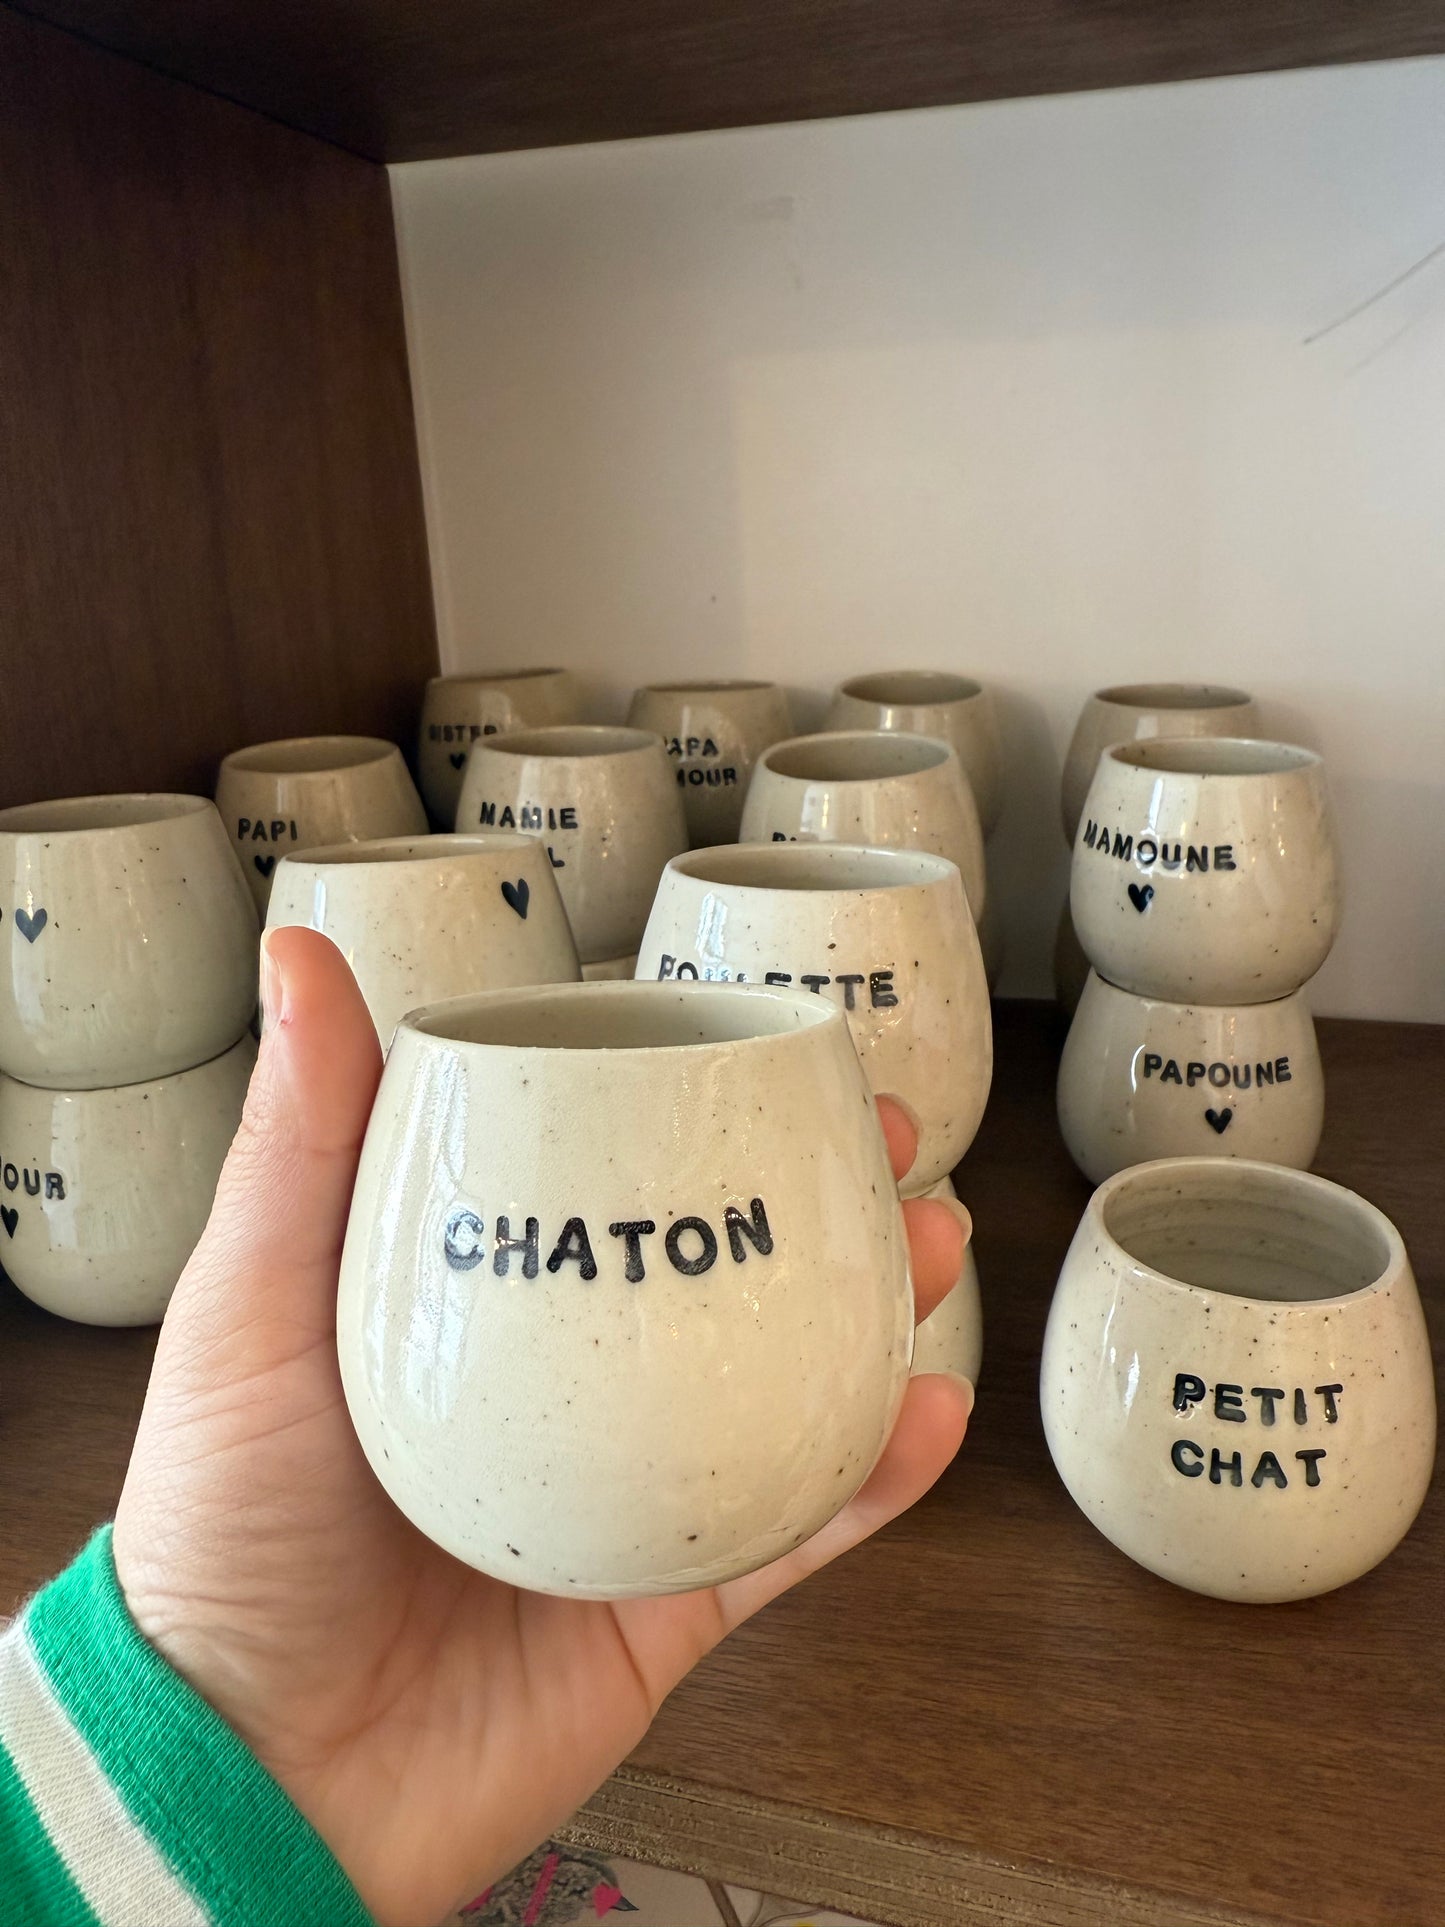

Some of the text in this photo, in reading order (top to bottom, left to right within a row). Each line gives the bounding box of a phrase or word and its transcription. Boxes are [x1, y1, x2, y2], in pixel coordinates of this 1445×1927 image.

[663, 736, 719, 756] APA
[238, 817, 297, 842] PAPI
[480, 802, 578, 830] MAMIE
[1083, 819, 1237, 873] MAMOUNE
[1143, 1053, 1292, 1089] PAPOUNE
[0, 1156, 66, 1200] OUR
[444, 1198, 774, 1284] CHATON
[1173, 1373, 1343, 1426] PETIT
[1171, 1439, 1327, 1489] CHAT
